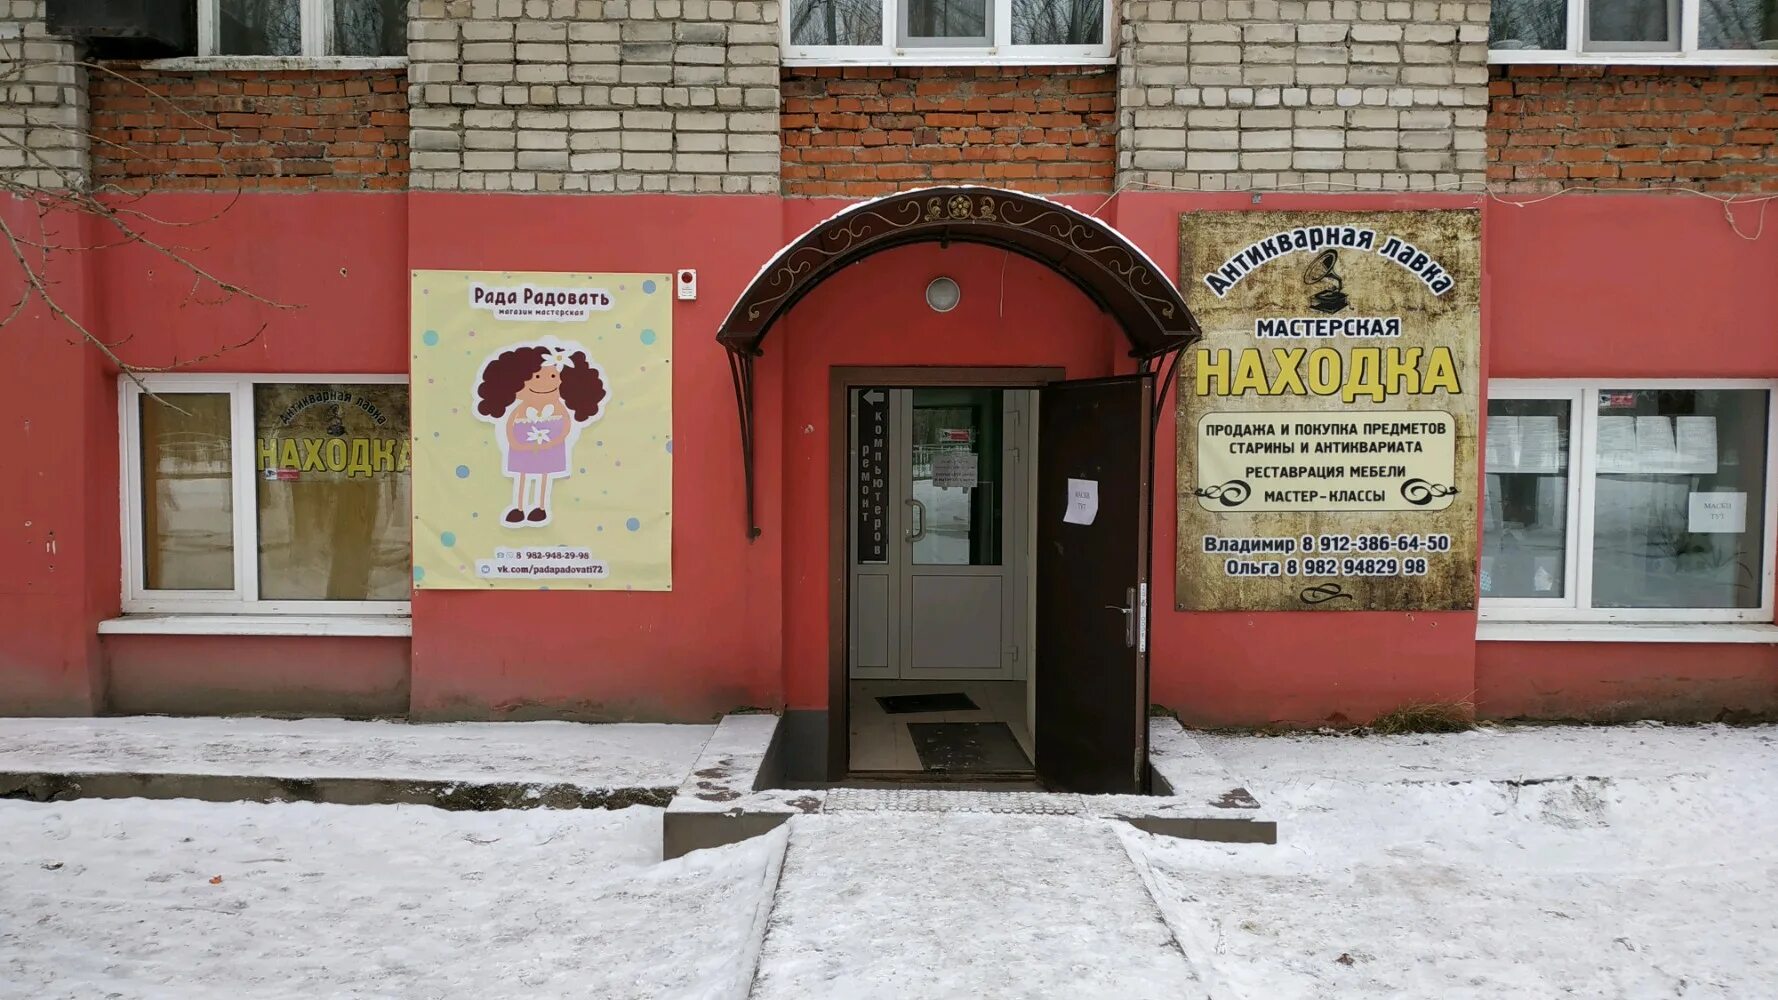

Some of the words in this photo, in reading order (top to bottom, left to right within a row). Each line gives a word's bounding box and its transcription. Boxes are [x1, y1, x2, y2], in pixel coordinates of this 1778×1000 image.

[1204, 226, 1375, 296] Антикварная
[1380, 237, 1454, 295] лавка
[474, 287, 517, 306] Рада
[523, 287, 609, 306] Радовать
[1257, 319, 1400, 337] МАСТЕРСКАЯ
[1196, 347, 1461, 403] НАХОДКА
[280, 391, 352, 424] Антикварная
[1206, 423, 1275, 437] ПРОДАЖА
[1281, 424, 1289, 435] И
[1295, 423, 1357, 436] ПОКУПКА
[1363, 422, 1446, 436] ПРЕДМЕТОВ
[1229, 441, 1295, 454] СТАРИНЫ
[1300, 442, 1309, 453] И
[1314, 441, 1423, 453] АНТИКВАРИАТА
[1245, 466, 1344, 479] РЕСТАВРАЦИЯ
[1350, 466, 1406, 478] МЕБЕЛИ
[861, 445, 870, 522] ремонт
[872, 411, 883, 555] компьютеров
[1204, 536, 1295, 554] Владимир
[1302, 536, 1313, 551] 8
[1320, 535, 1449, 551] 912-386-64-50
[516, 551, 522, 559] 8
[526, 551, 589, 559] 982-948-29-98
[497, 565, 603, 574] vk.com/padapadovati72
[1226, 559, 1279, 576] Ольга
[1286, 560, 1298, 575] 8
[1304, 560, 1337, 575] 982
[1344, 559, 1397, 574] 94829
[1404, 559, 1426, 574] 98
